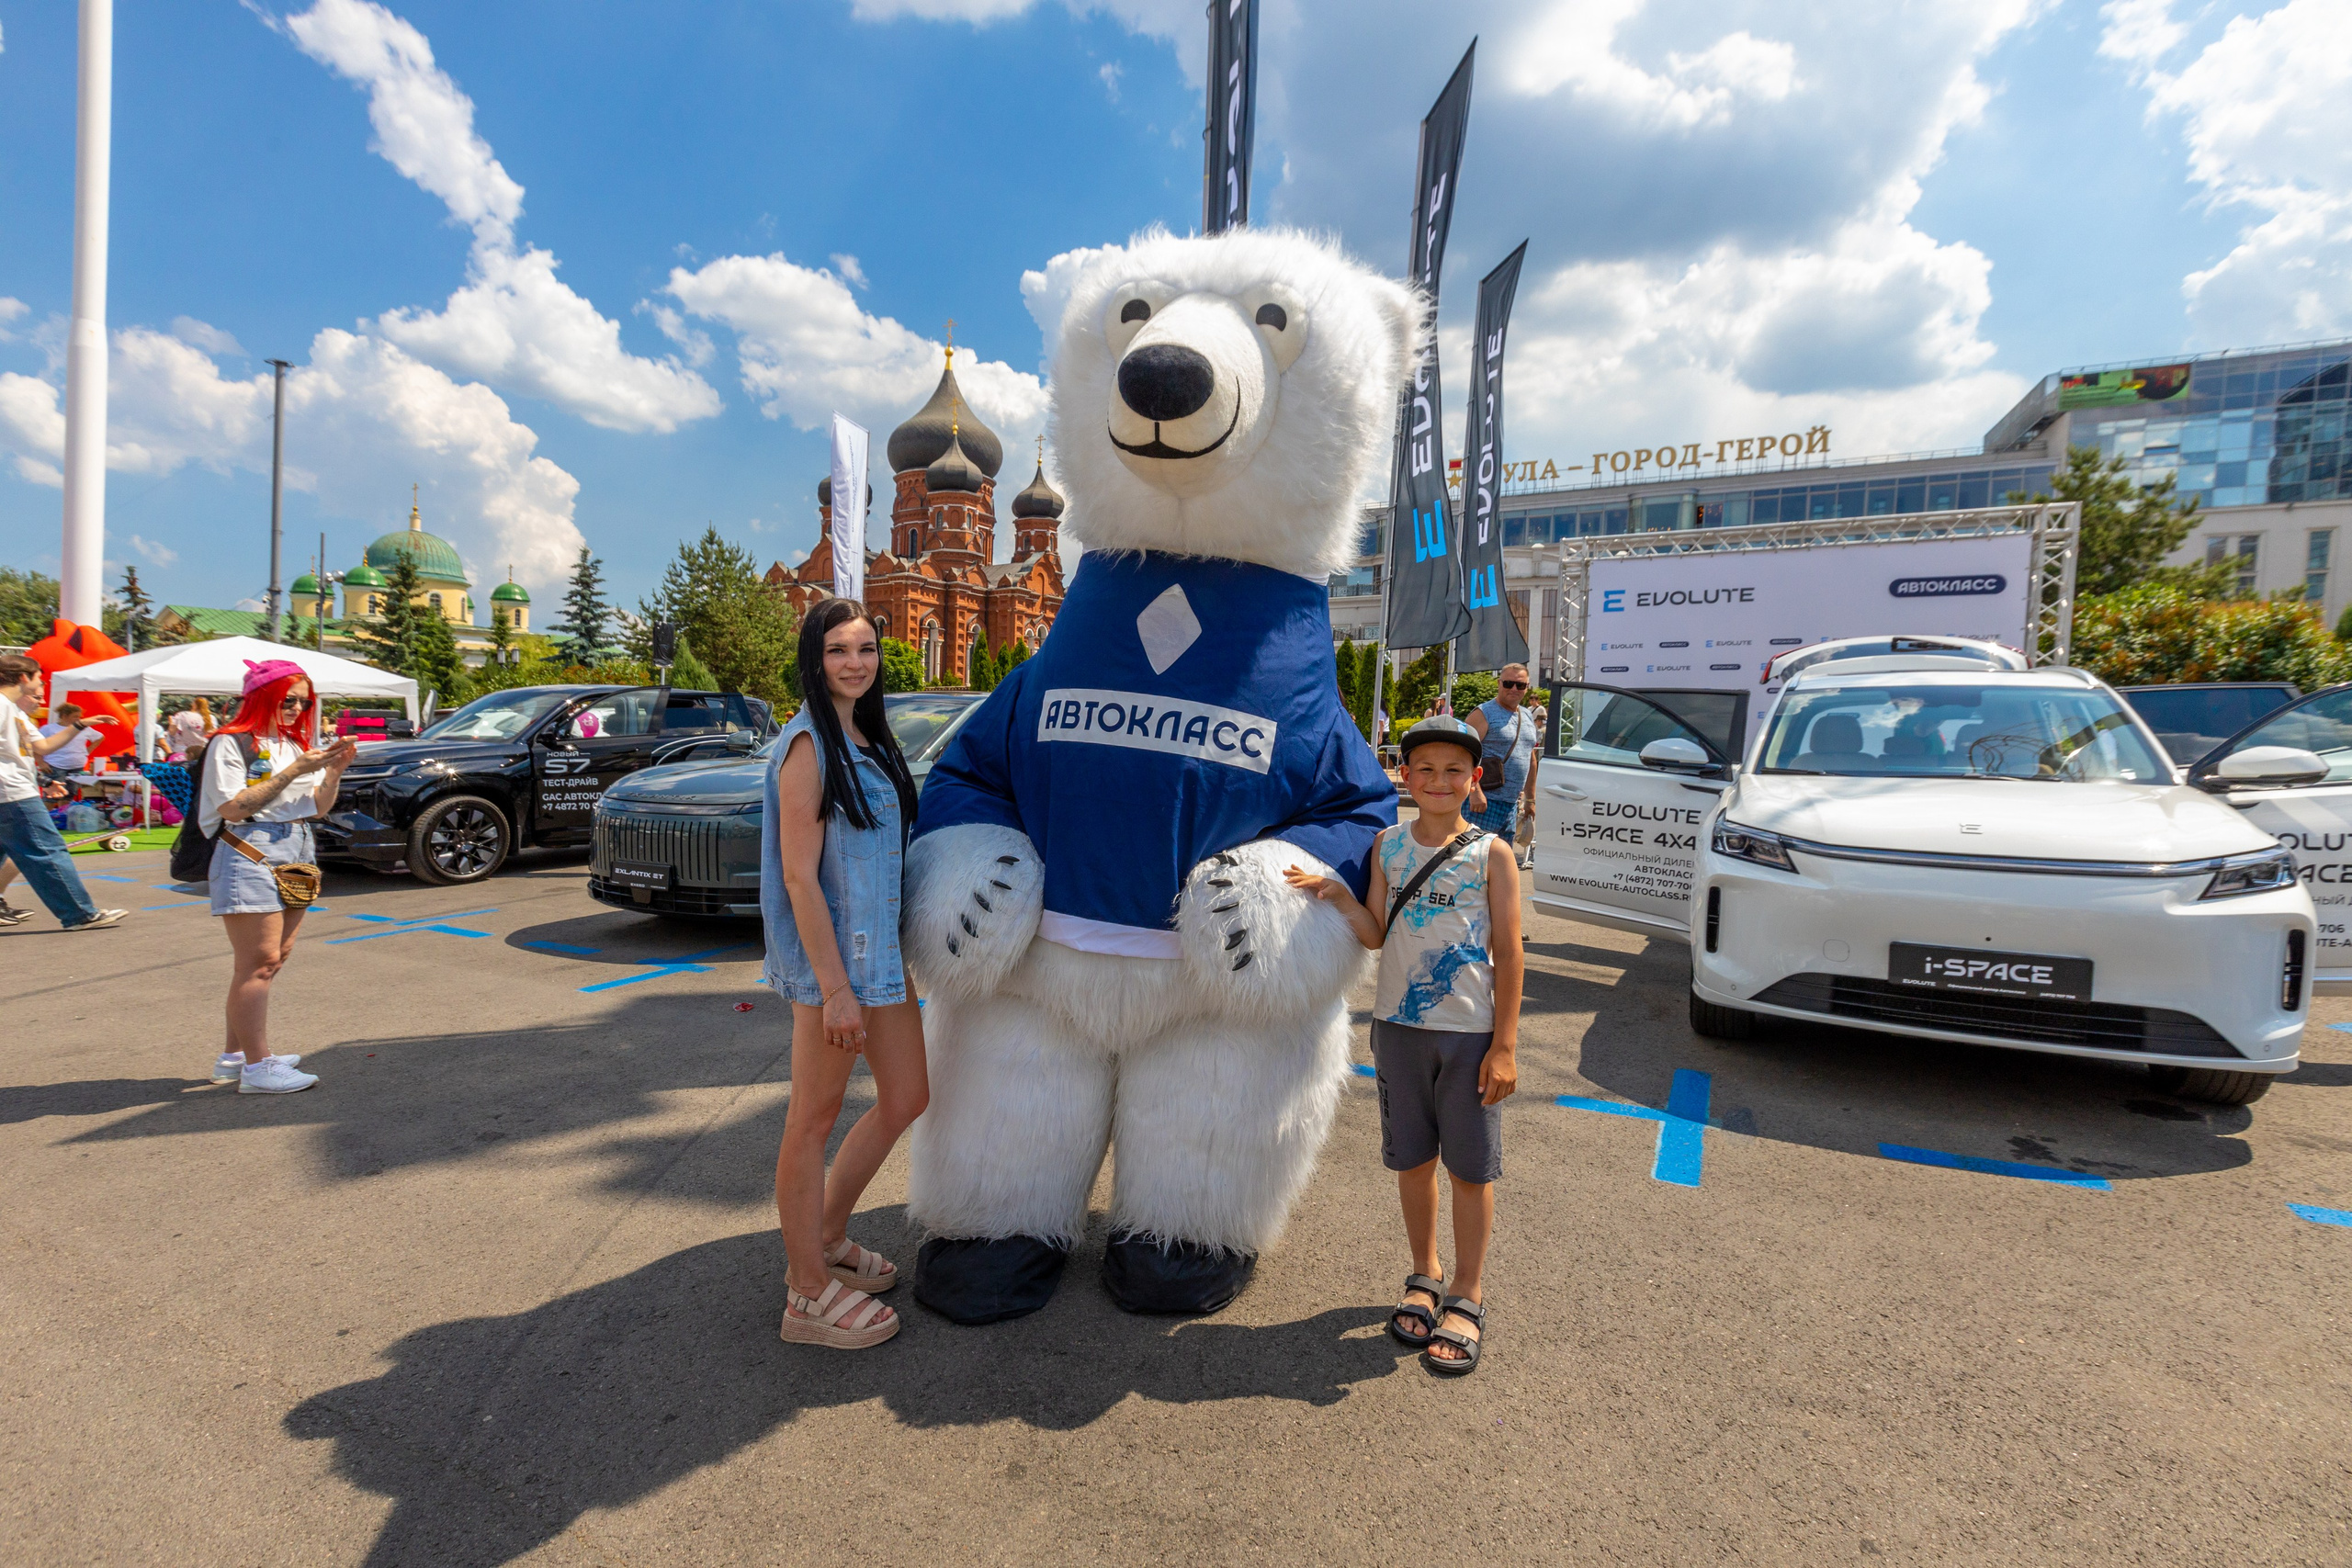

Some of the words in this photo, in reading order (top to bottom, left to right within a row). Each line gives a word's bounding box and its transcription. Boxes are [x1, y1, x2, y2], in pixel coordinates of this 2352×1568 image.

[1503, 458, 1560, 484] УЛА
[1591, 425, 1833, 475] ГОРОД-ГЕРОЙ
[1897, 577, 1998, 594] АВТОКЛАСС
[1636, 587, 1756, 607] EVOLUTE
[1046, 700, 1265, 758] АВТОКЛАСС
[545, 759, 591, 773] S7
[542, 777, 599, 787] ТЕСТ-ДРАЙВ
[1592, 801, 1702, 825] EVOLUTE
[1561, 822, 1644, 844] i-SPACE
[1654, 832, 1696, 851] 4X4
[1583, 848, 1661, 863] ОФИЦИАЛЬНЫЙ
[1663, 857, 1694, 868] ДИЛЕ
[615, 868, 650, 877] EXLANTIX
[1625, 874, 1655, 886] (4872)
[1429, 892, 1455, 907] SEA
[1578, 878, 1690, 901] EVOLUTE-AUTOCLASS.R
[1925, 956, 2053, 985] i-SPACE
[1902, 978, 1936, 987] EVOLUTE
